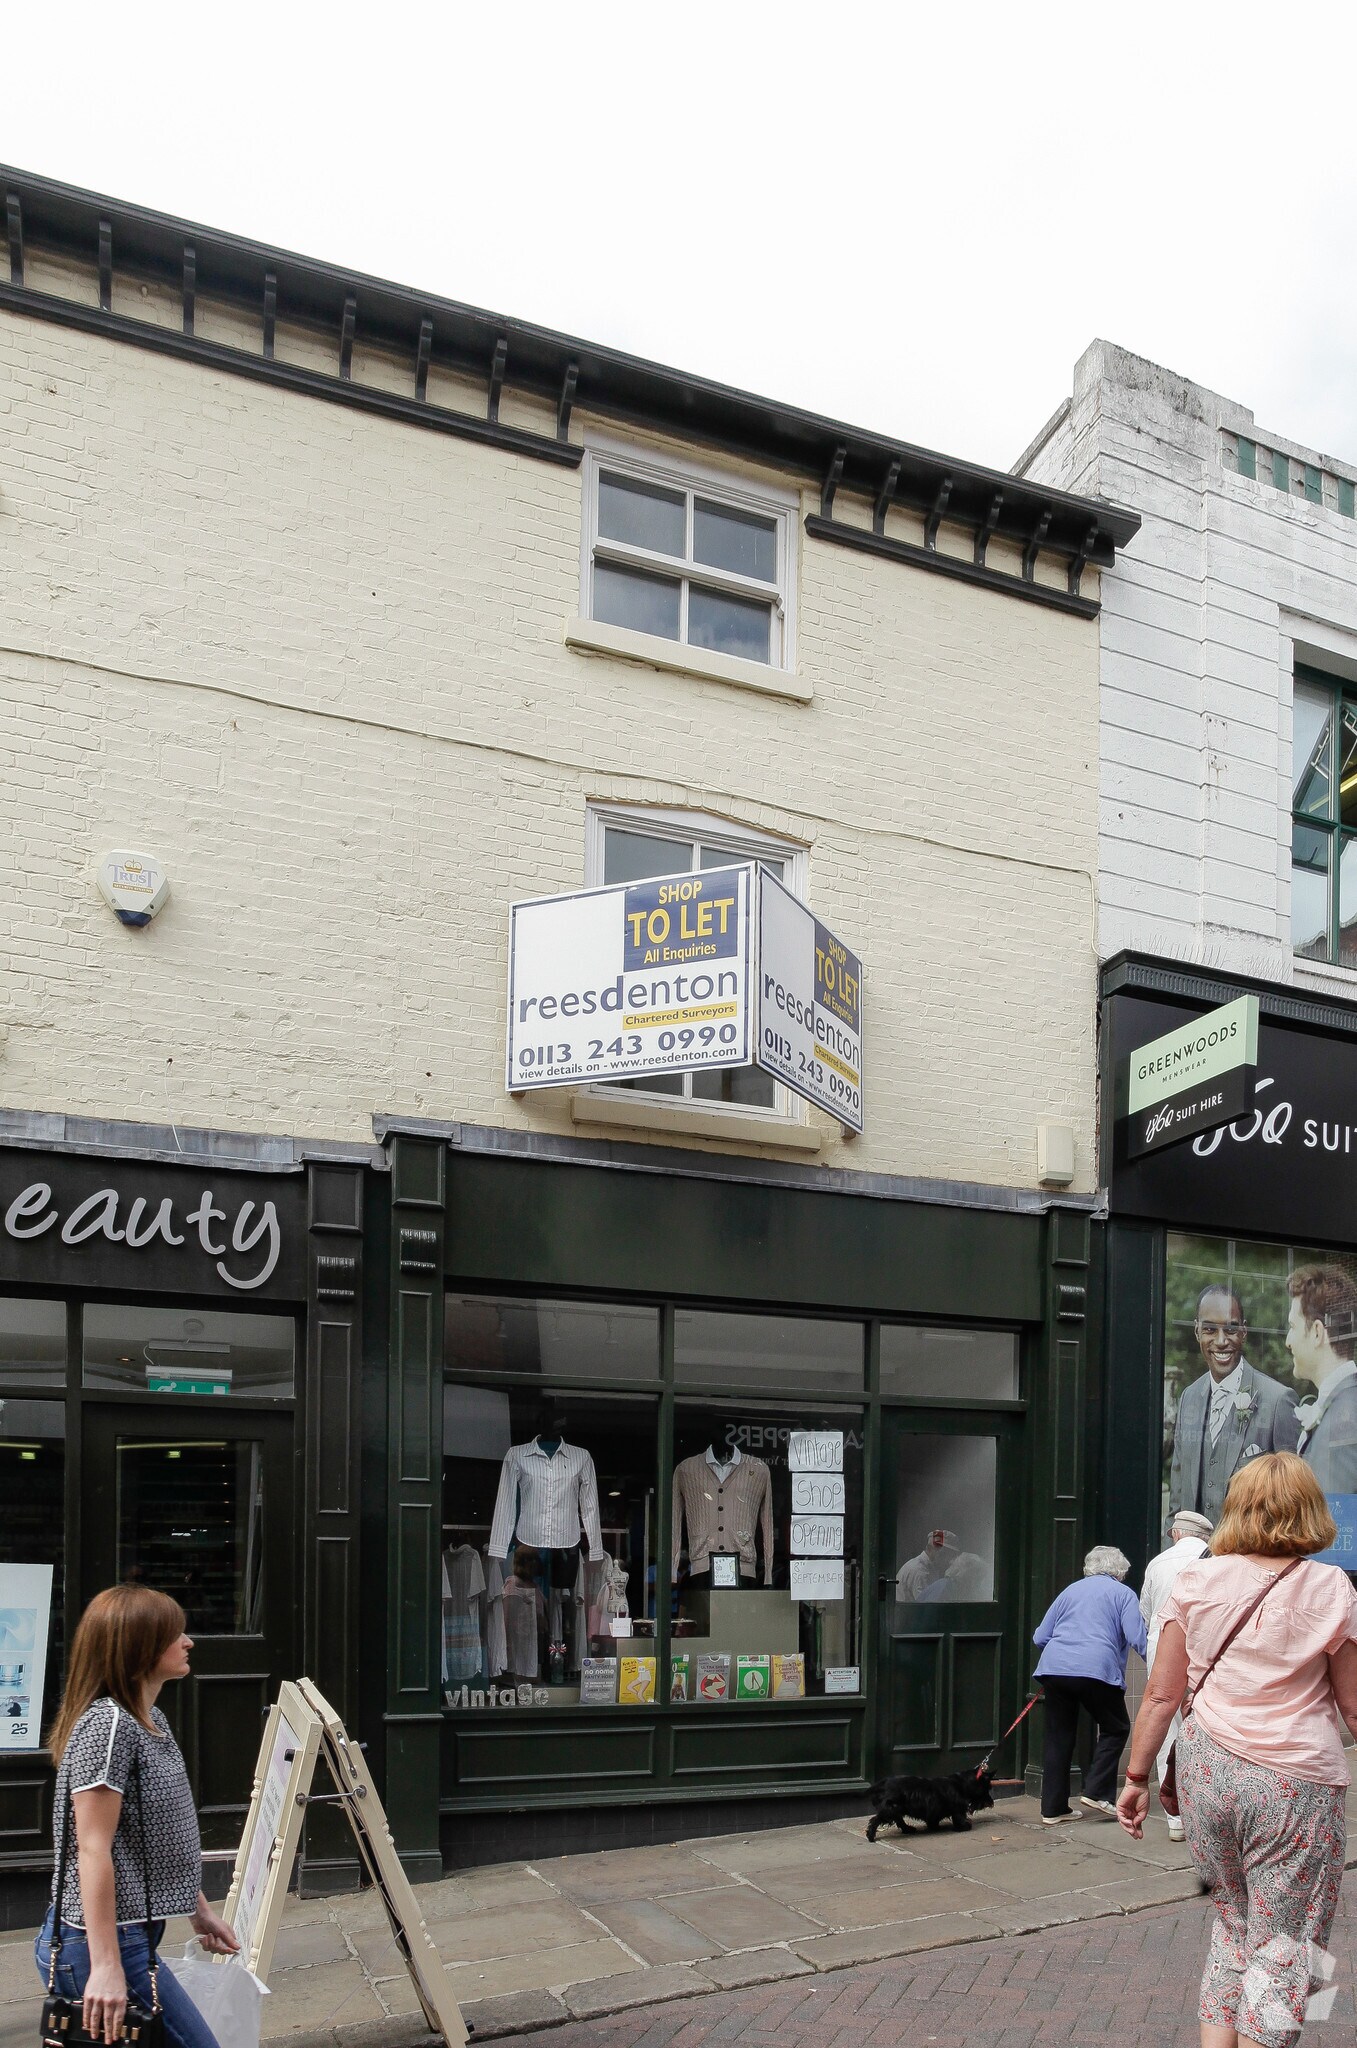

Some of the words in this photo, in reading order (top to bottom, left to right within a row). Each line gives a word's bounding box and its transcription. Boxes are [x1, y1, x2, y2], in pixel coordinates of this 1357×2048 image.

[108, 864, 158, 887] TRUST
[658, 880, 703, 905] SHOP
[627, 908, 671, 947] TO
[680, 897, 735, 940] LET
[643, 948, 660, 964] All
[663, 942, 717, 962] Enquiries
[828, 938, 847, 966] SHOP
[815, 946, 836, 991] TO
[838, 966, 858, 1011] LET
[519, 971, 738, 1023] reesdenton
[823, 990, 831, 1006] All
[831, 996, 854, 1025] Enquiries
[625, 1011, 680, 1025] Chartered
[681, 1005, 735, 1018] Surveyors
[764, 973, 860, 1070] reesdenton
[518, 1043, 572, 1067] 0113
[587, 1035, 643, 1060] 243
[657, 1023, 737, 1051] 0990
[814, 1045, 839, 1069] Chartered
[1138, 1021, 1238, 1080] GREENWOODS
[518, 1068, 544, 1079] view
[546, 1063, 583, 1076] details
[586, 1063, 600, 1072] on
[609, 1047, 737, 1069] www.reesdenton.com
[764, 1027, 792, 1062] 0113
[798, 1051, 824, 1084] 243
[829, 1073, 860, 1110] 0990
[1162, 1058, 1207, 1083] MENSWEAR
[764, 1050, 778, 1065] view
[778, 1060, 797, 1081] details
[797, 1074, 805, 1084] on
[808, 1079, 860, 1122] www.reesdenton.com
[1176, 1103, 1198, 1122] SUIT
[1200, 1092, 1223, 1112] HIRE
[1303, 1119, 1357, 1153] SUI
[4, 1182, 282, 1290] eauty
[792, 1572, 844, 1585] SEPTEMBER
[444, 1683, 549, 1707] vintage
[11, 1722, 28, 1735] 25
